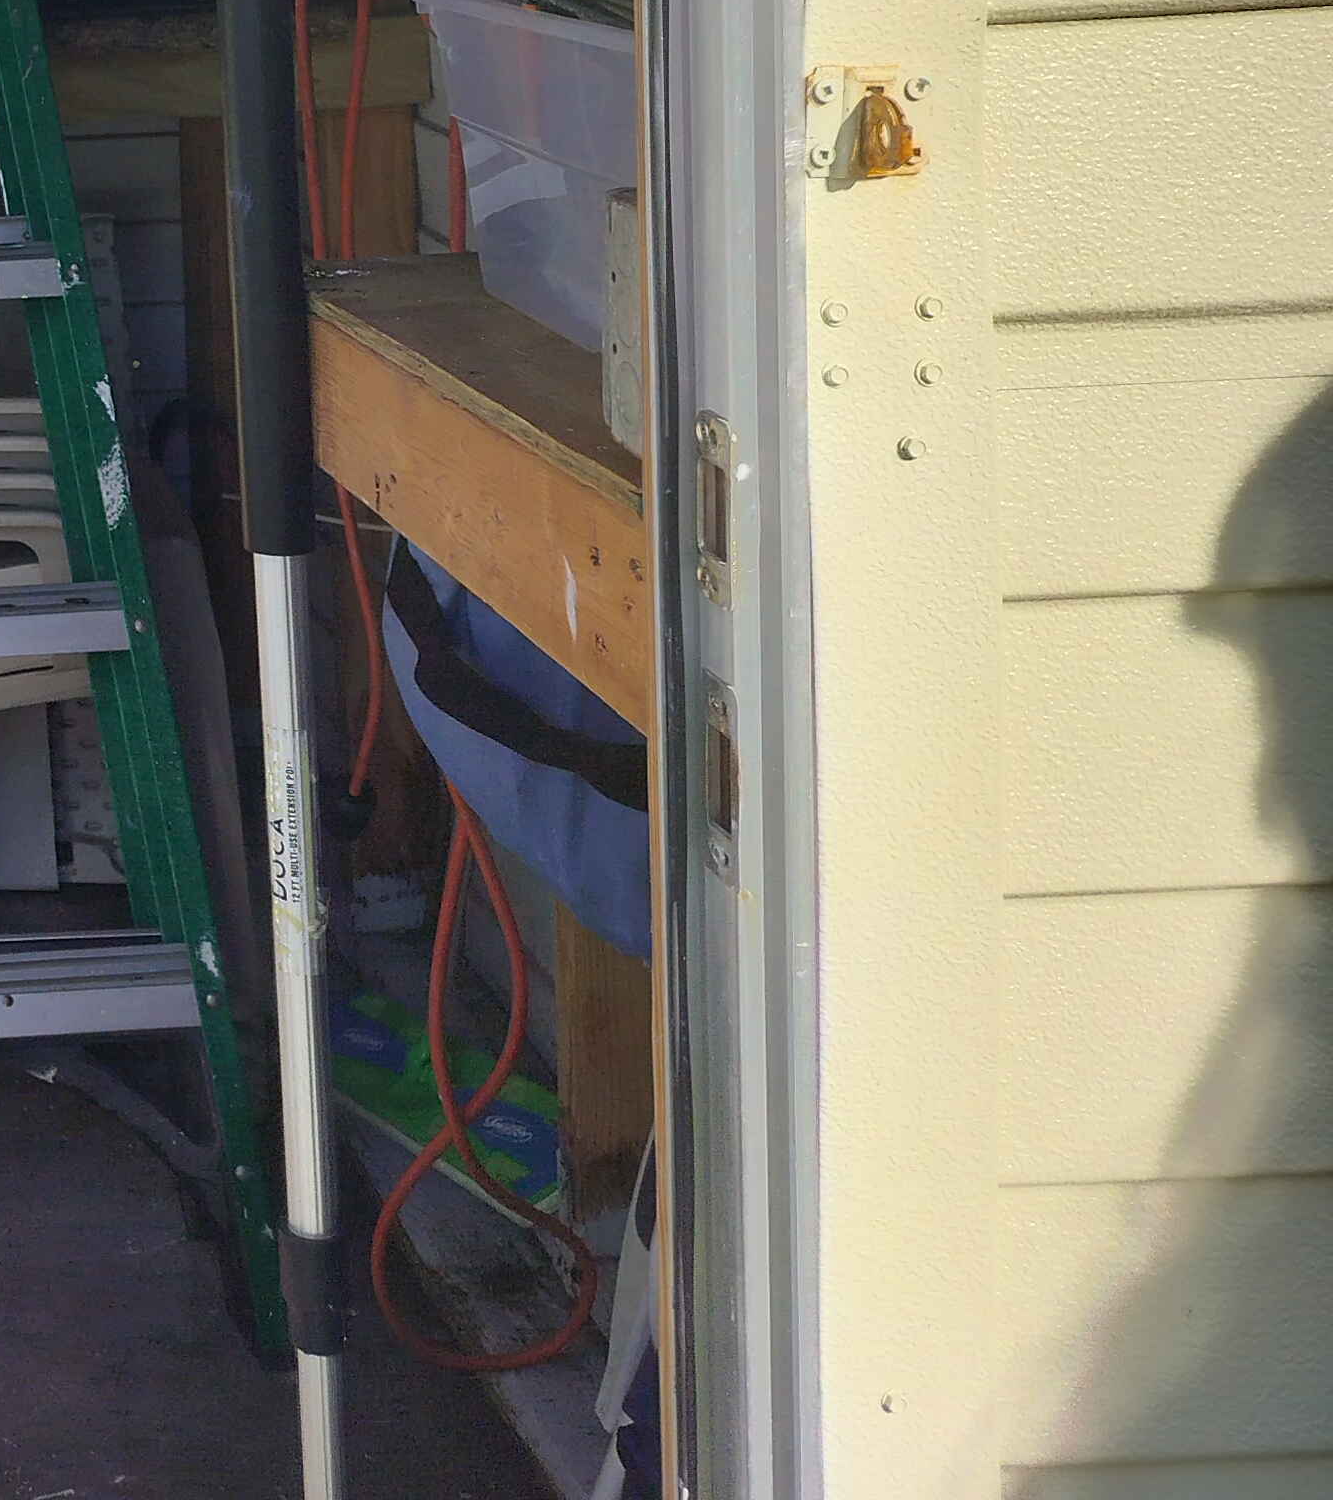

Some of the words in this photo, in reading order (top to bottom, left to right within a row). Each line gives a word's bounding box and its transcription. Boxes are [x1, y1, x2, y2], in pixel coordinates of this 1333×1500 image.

[287, 782, 298, 830] EXTENSION
[289, 832, 300, 879] MULTI-USE
[292, 880, 301, 891] FT
[292, 892, 301, 904] 12
